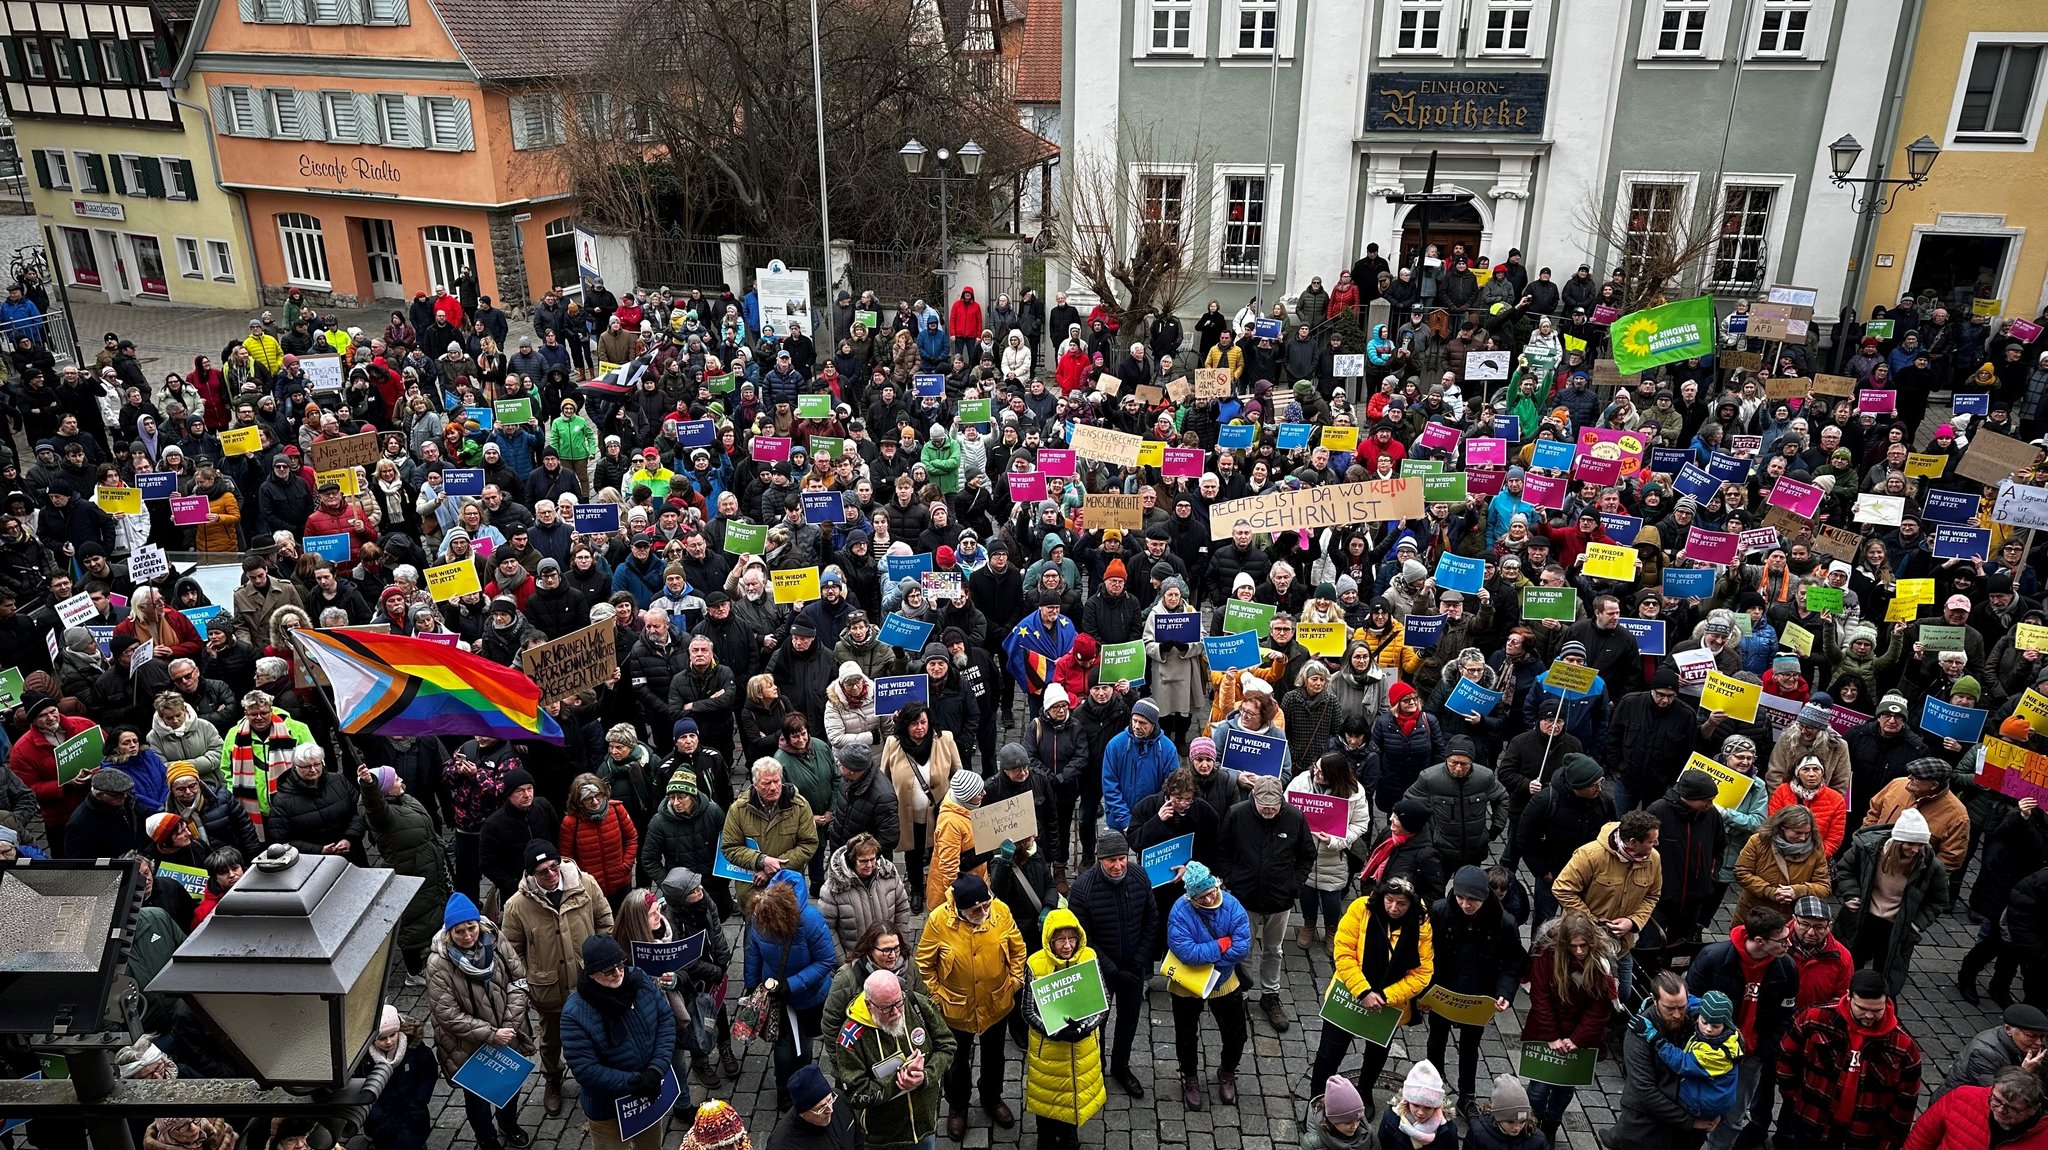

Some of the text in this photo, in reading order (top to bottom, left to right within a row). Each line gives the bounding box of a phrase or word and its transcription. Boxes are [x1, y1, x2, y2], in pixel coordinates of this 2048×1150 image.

[1420, 81, 1504, 94] EINHORN-
[1381, 89, 1528, 129] Apotheke
[299, 154, 400, 183] Eiscafe Rialto
[1753, 324, 1773, 334] AFD
[1196, 370, 1216, 379] MEINE
[1199, 380, 1215, 389] ARME
[1076, 427, 1140, 448] MENSCHENRECHTE
[1584, 434, 1597, 443] Nie
[341, 438, 374, 453] Wieder
[1094, 441, 1127, 454] STATT
[329, 457, 340, 468] ist
[1085, 496, 1140, 510] MENSCHENRECHTE
[1212, 496, 1264, 517] RECHTS
[1274, 492, 1298, 507] IST
[1312, 487, 1331, 503] DA
[1340, 483, 1363, 497] WO
[1249, 500, 1381, 528] GEHIRN IST
[737, 527, 756, 535] WIEDER
[134, 552, 157, 563] OPAS
[132, 558, 162, 571] GEGEN
[1452, 561, 1475, 569] WIEDER
[132, 565, 166, 579] RECHTS
[440, 567, 462, 577] WIEDER
[57, 603, 67, 611] Nie
[68, 594, 89, 606] wieder
[69, 615, 78, 623] ist
[78, 610, 92, 621] jetzt
[1117, 647, 1136, 655] WIEDER
[529, 650, 553, 671] WIR
[587, 661, 608, 686] TUN
[1709, 676, 1744, 693] NIE WIEDER
[1929, 702, 1970, 719] NIE WIEDER
[58, 737, 88, 758] NIE WIEDER
[1244, 738, 1270, 749] WIEDER
[60, 757, 69, 765] IST
[993, 821, 1018, 834] Würde
[1145, 843, 1180, 860] NIE WIEDER
[1145, 860, 1154, 868] IST
[1037, 972, 1082, 996] NIE WIEDER
[1040, 996, 1051, 1006] IST
[478, 1051, 489, 1061] IST
[483, 1043, 520, 1071] NIE WIEDER
